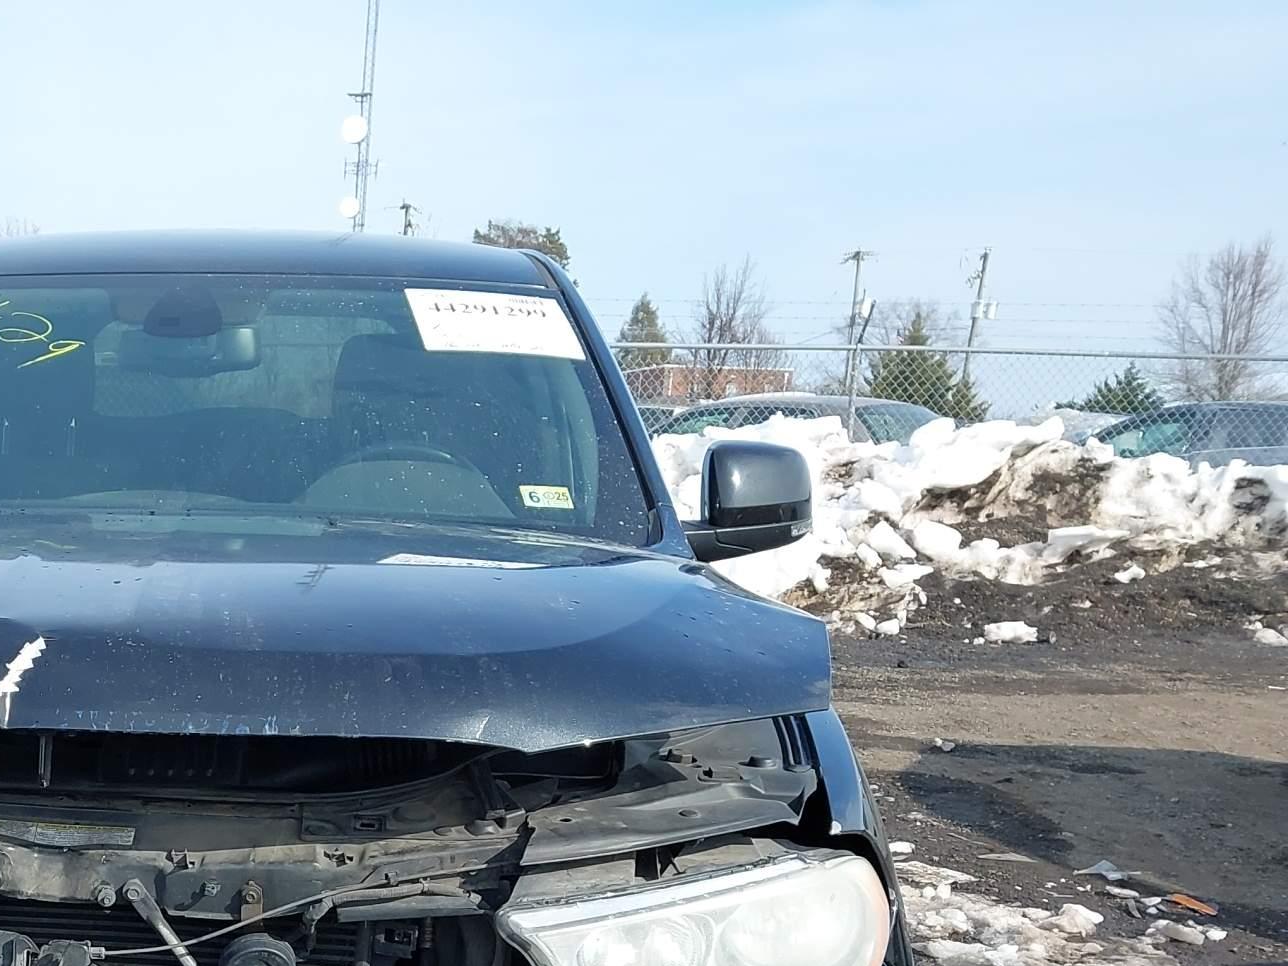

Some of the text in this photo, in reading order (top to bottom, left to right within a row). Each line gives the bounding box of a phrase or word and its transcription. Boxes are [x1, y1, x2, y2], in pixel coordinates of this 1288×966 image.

[428, 302, 548, 319] 44291299
[528, 491, 569, 504] 6 25
